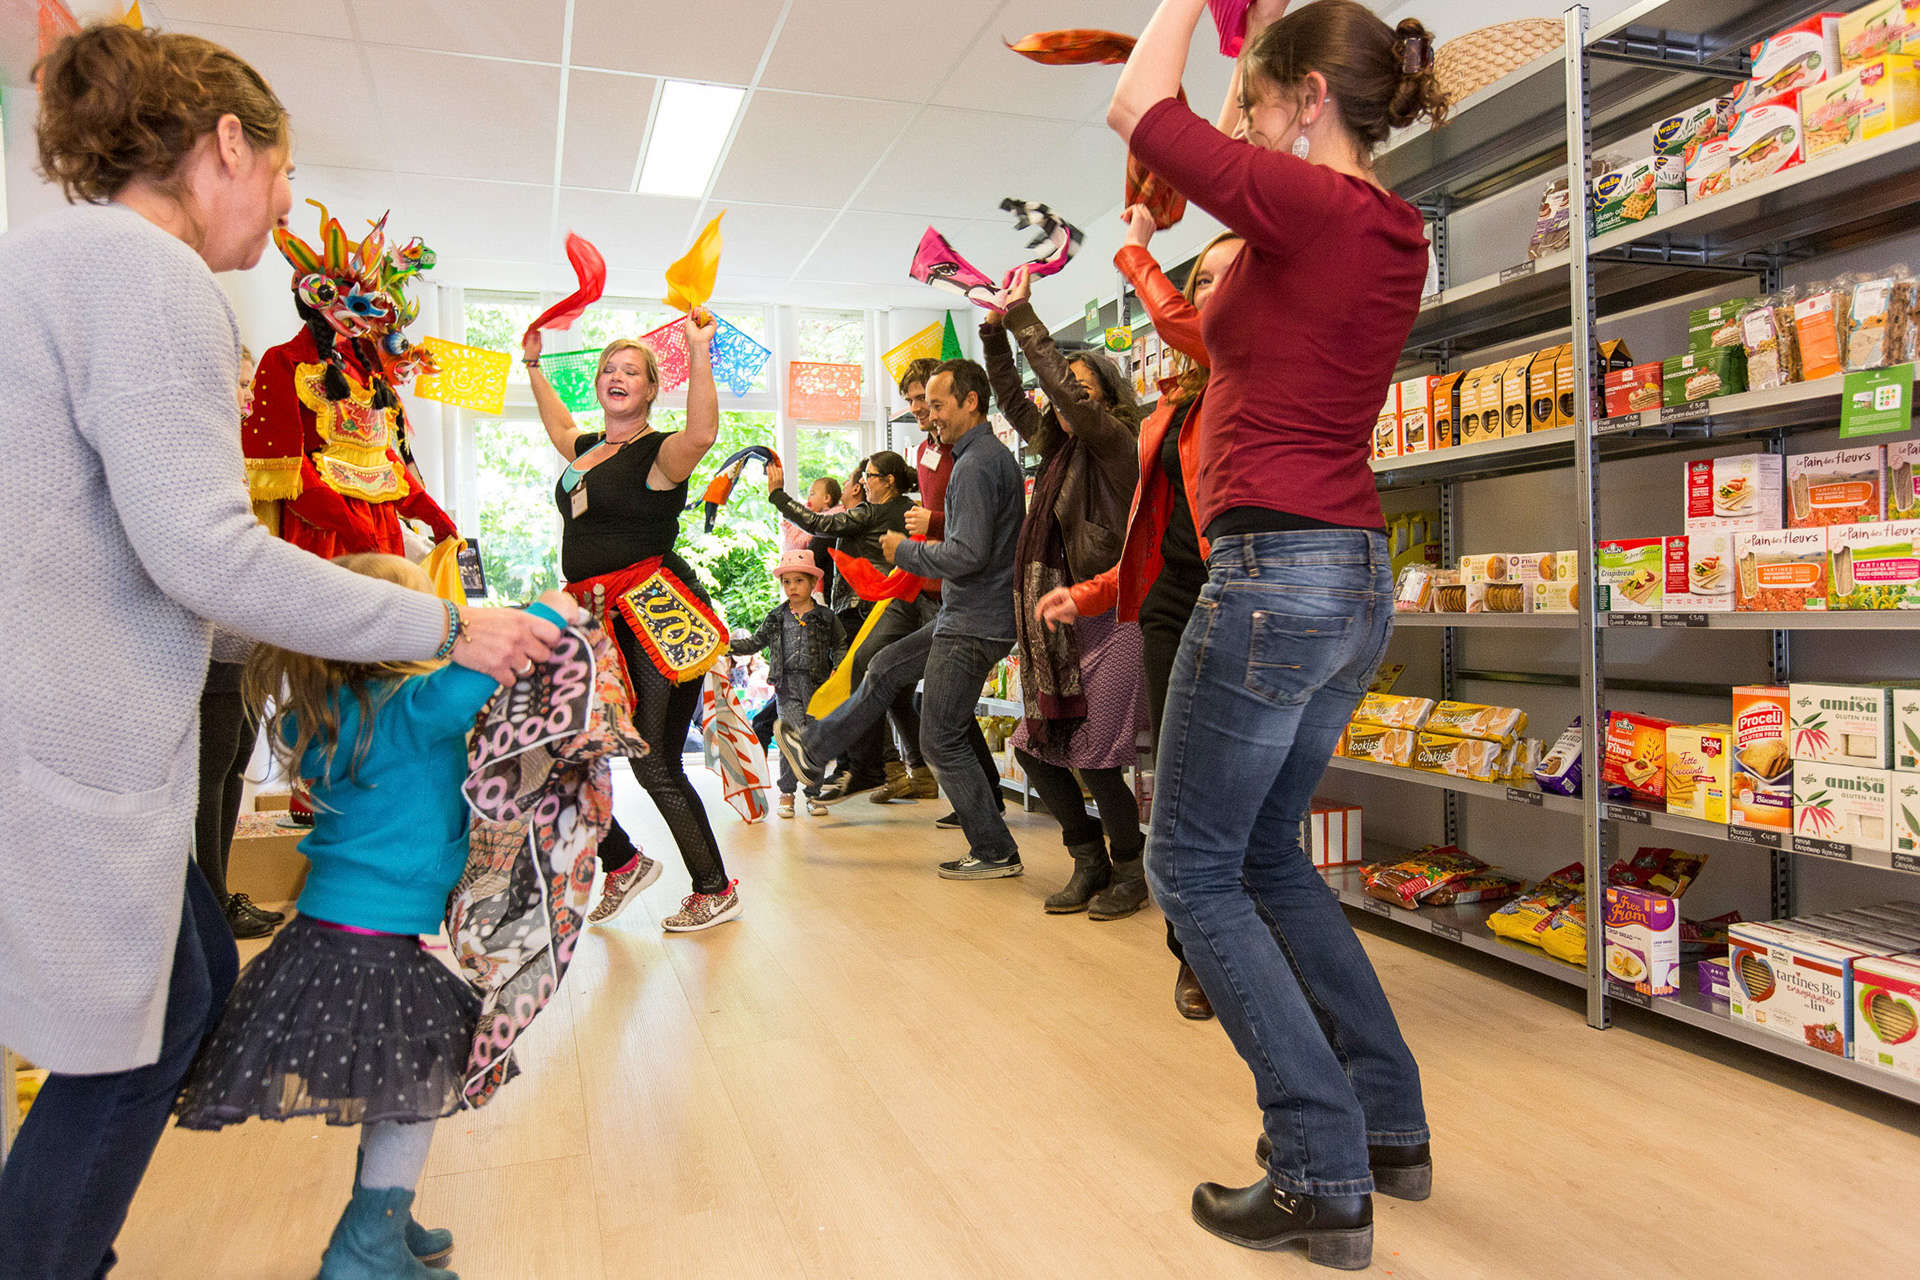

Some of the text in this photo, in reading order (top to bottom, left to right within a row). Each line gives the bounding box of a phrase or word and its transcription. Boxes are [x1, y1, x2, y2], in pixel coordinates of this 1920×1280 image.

[1804, 456, 1823, 468] Pain
[1835, 452, 1871, 464] fleurs
[1752, 534, 1771, 547] Pain
[1783, 531, 1819, 544] fleurs
[1848, 527, 1870, 540] Pain
[1820, 698, 1877, 713] amisa
[1431, 713, 1472, 723] Cookies
[1740, 711, 1781, 730] Proceli
[1608, 735, 1635, 747] Essential
[1741, 732, 1763, 741] GLUTEN
[1418, 750, 1452, 762] Cookies
[1606, 742, 1632, 757] Fibre
[1825, 777, 1884, 794] amisa
[1756, 795, 1784, 806] Biscottes
[1841, 792, 1867, 800] GLUTEN
[1620, 895, 1642, 911] Free
[1608, 904, 1649, 923] From
[1607, 928, 1633, 940] CRISP BREAD
[1776, 969, 1841, 999] tartines Bio
[1810, 999, 1826, 1013] lin
